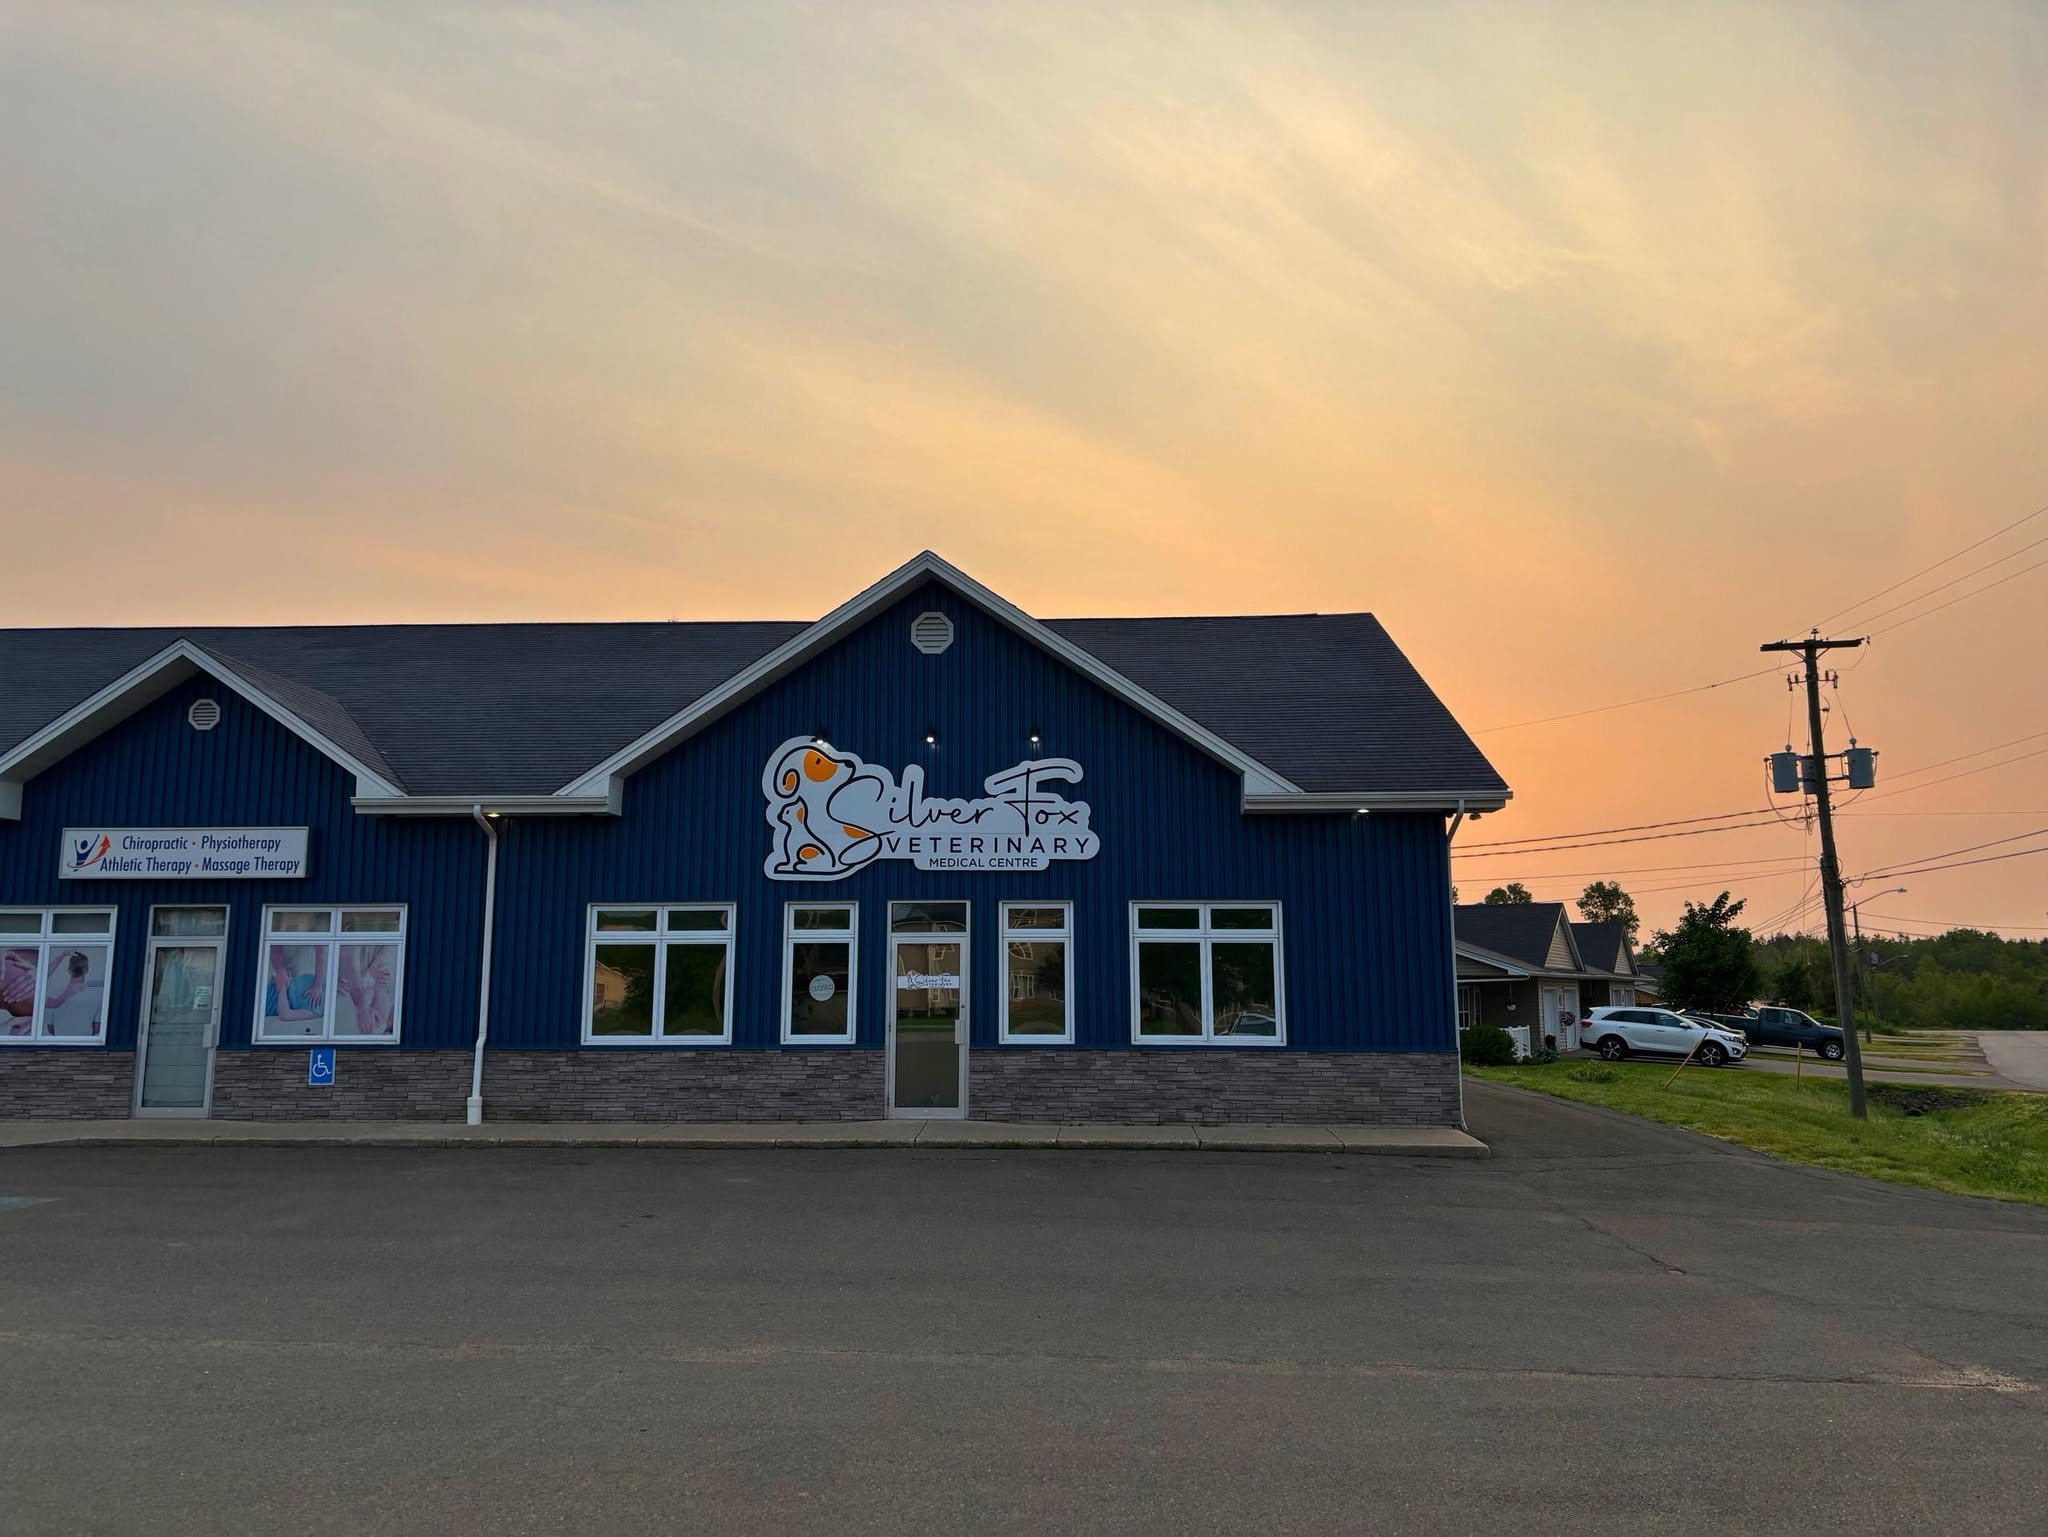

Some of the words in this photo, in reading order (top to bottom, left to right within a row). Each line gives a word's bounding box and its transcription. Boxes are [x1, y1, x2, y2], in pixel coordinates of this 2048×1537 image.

[826, 775, 994, 866] Silver
[994, 766, 1079, 837] Fox
[122, 835, 188, 852] Chiropractic
[201, 835, 281, 852] Physiotherapy
[886, 837, 1091, 854] VETERINARY
[100, 857, 142, 872] Athletic
[146, 858, 192, 874] Therapy
[201, 857, 250, 874] Massage
[254, 856, 300, 874] Therapy
[929, 857, 985, 868] MEDICAL
[988, 857, 1038, 868] CENTRE
